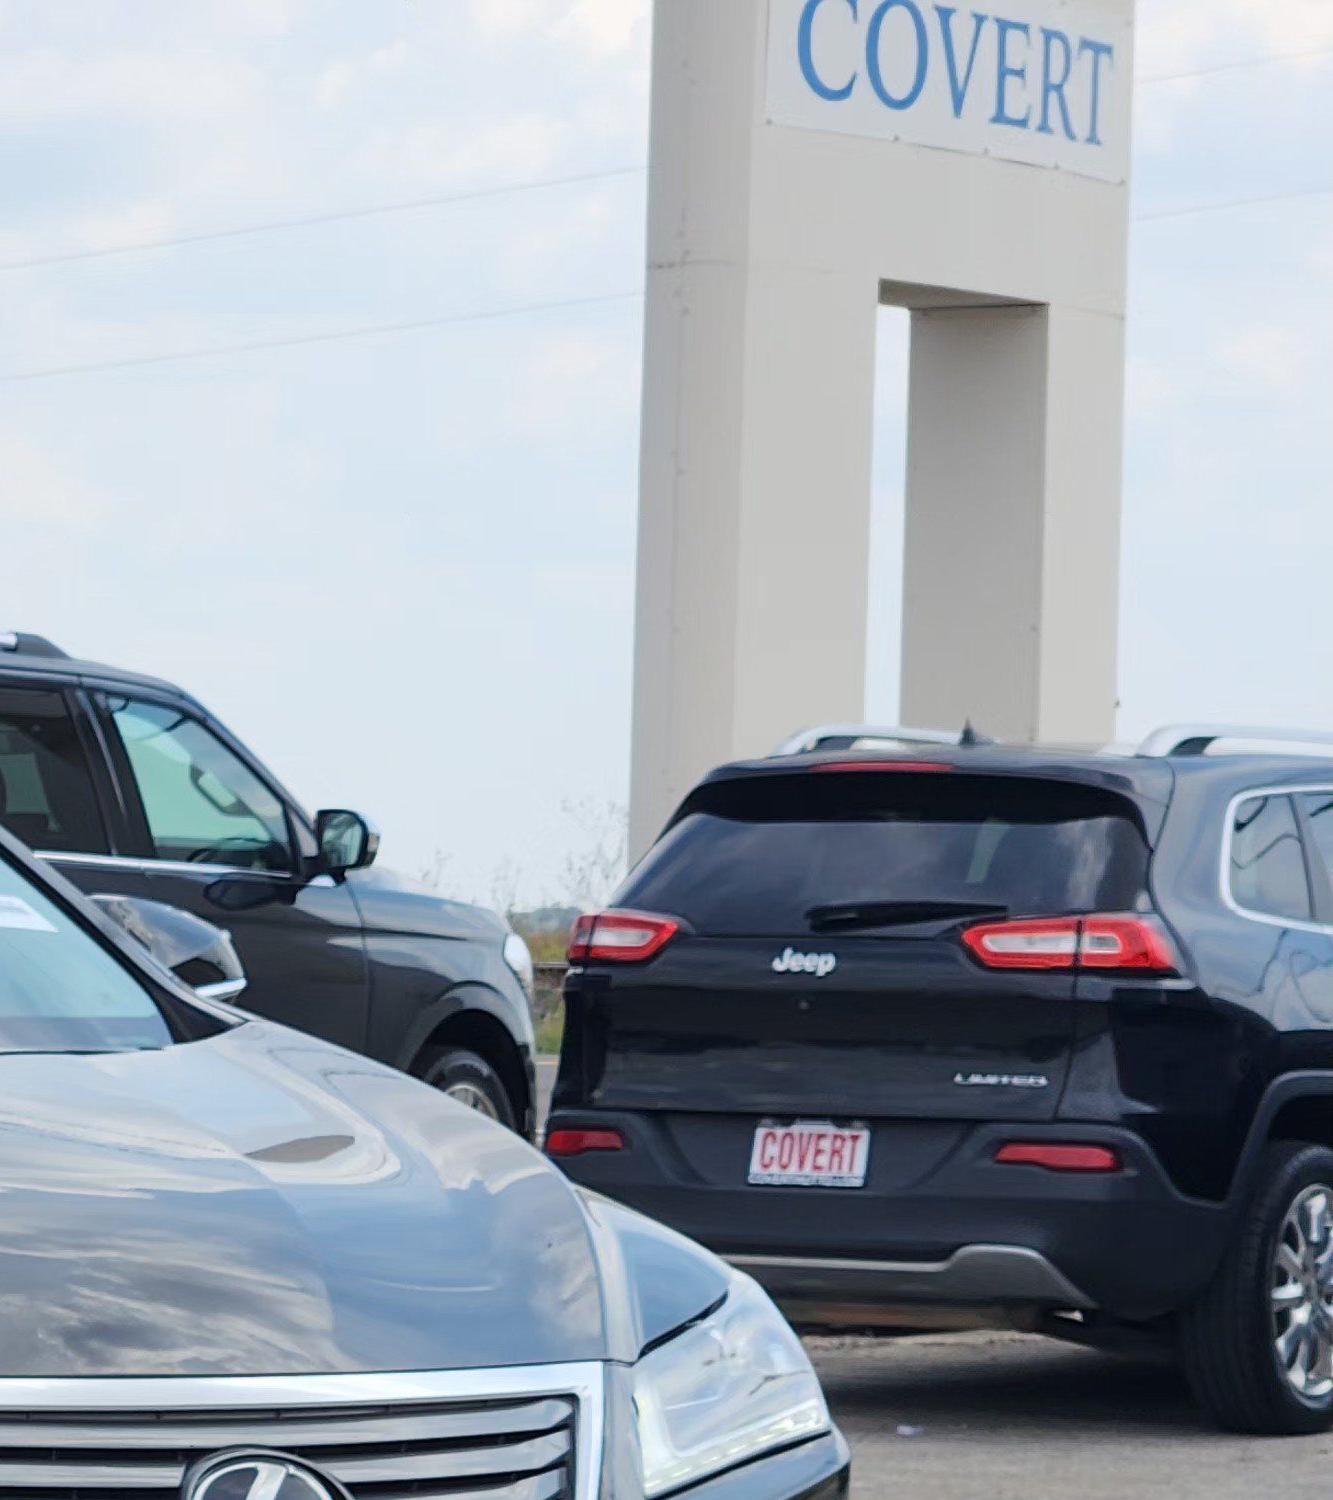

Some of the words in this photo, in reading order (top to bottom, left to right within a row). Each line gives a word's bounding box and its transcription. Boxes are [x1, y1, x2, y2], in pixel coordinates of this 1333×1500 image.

[797, 0, 1115, 146] COVERT
[771, 946, 837, 977] Jeep
[953, 1072, 1049, 1087] LIMITED
[759, 1130, 863, 1174] COVERT
